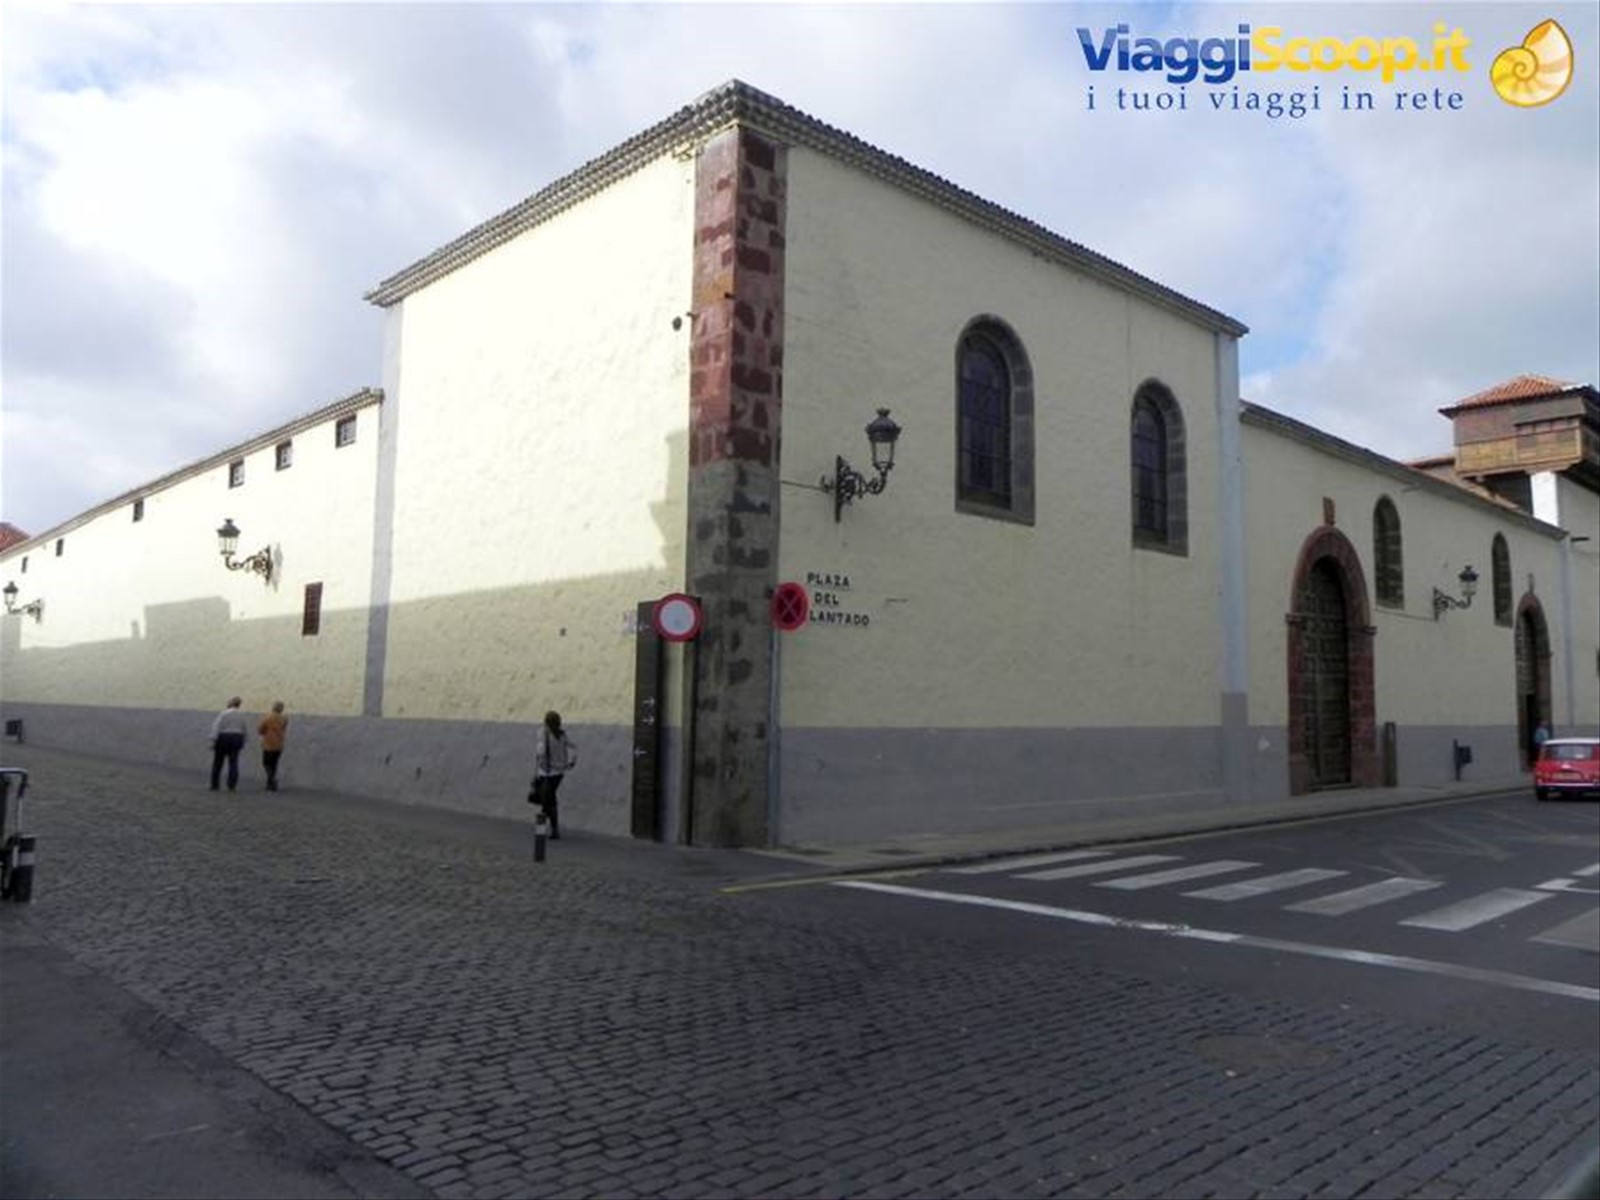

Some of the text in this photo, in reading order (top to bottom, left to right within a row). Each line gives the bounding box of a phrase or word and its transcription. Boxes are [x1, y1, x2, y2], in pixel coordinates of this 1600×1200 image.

[807, 572, 850, 587] PLAZA
[815, 592, 839, 605] DEL
[810, 610, 870, 626] LANTADO
